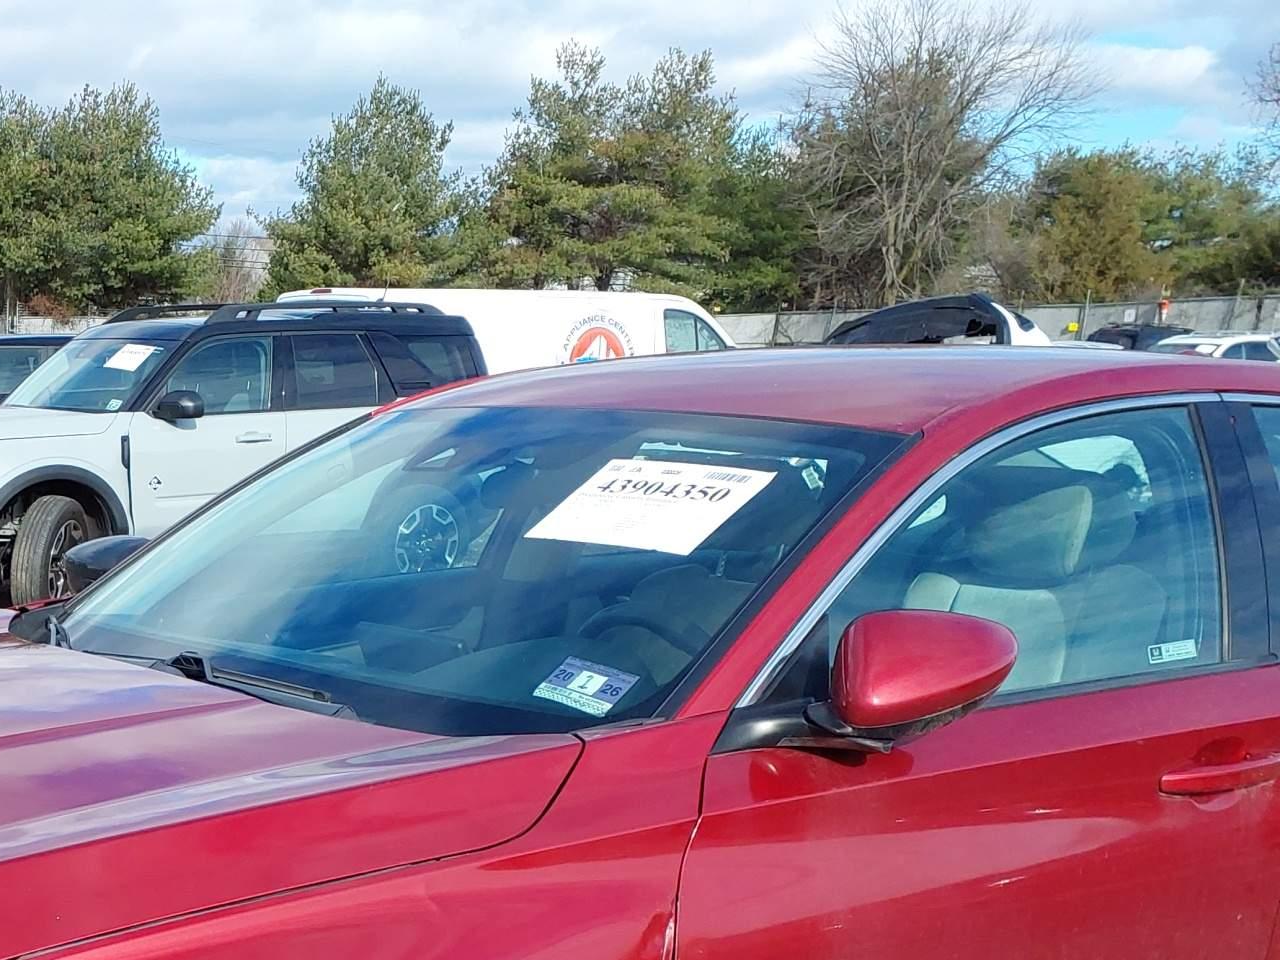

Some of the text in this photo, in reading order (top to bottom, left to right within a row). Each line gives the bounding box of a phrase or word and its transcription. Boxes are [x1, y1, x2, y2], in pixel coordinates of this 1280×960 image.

[563, 315, 606, 352] APPLIANCE
[598, 478, 731, 503] 43904350
[553, 669, 623, 697] 20 1 26
